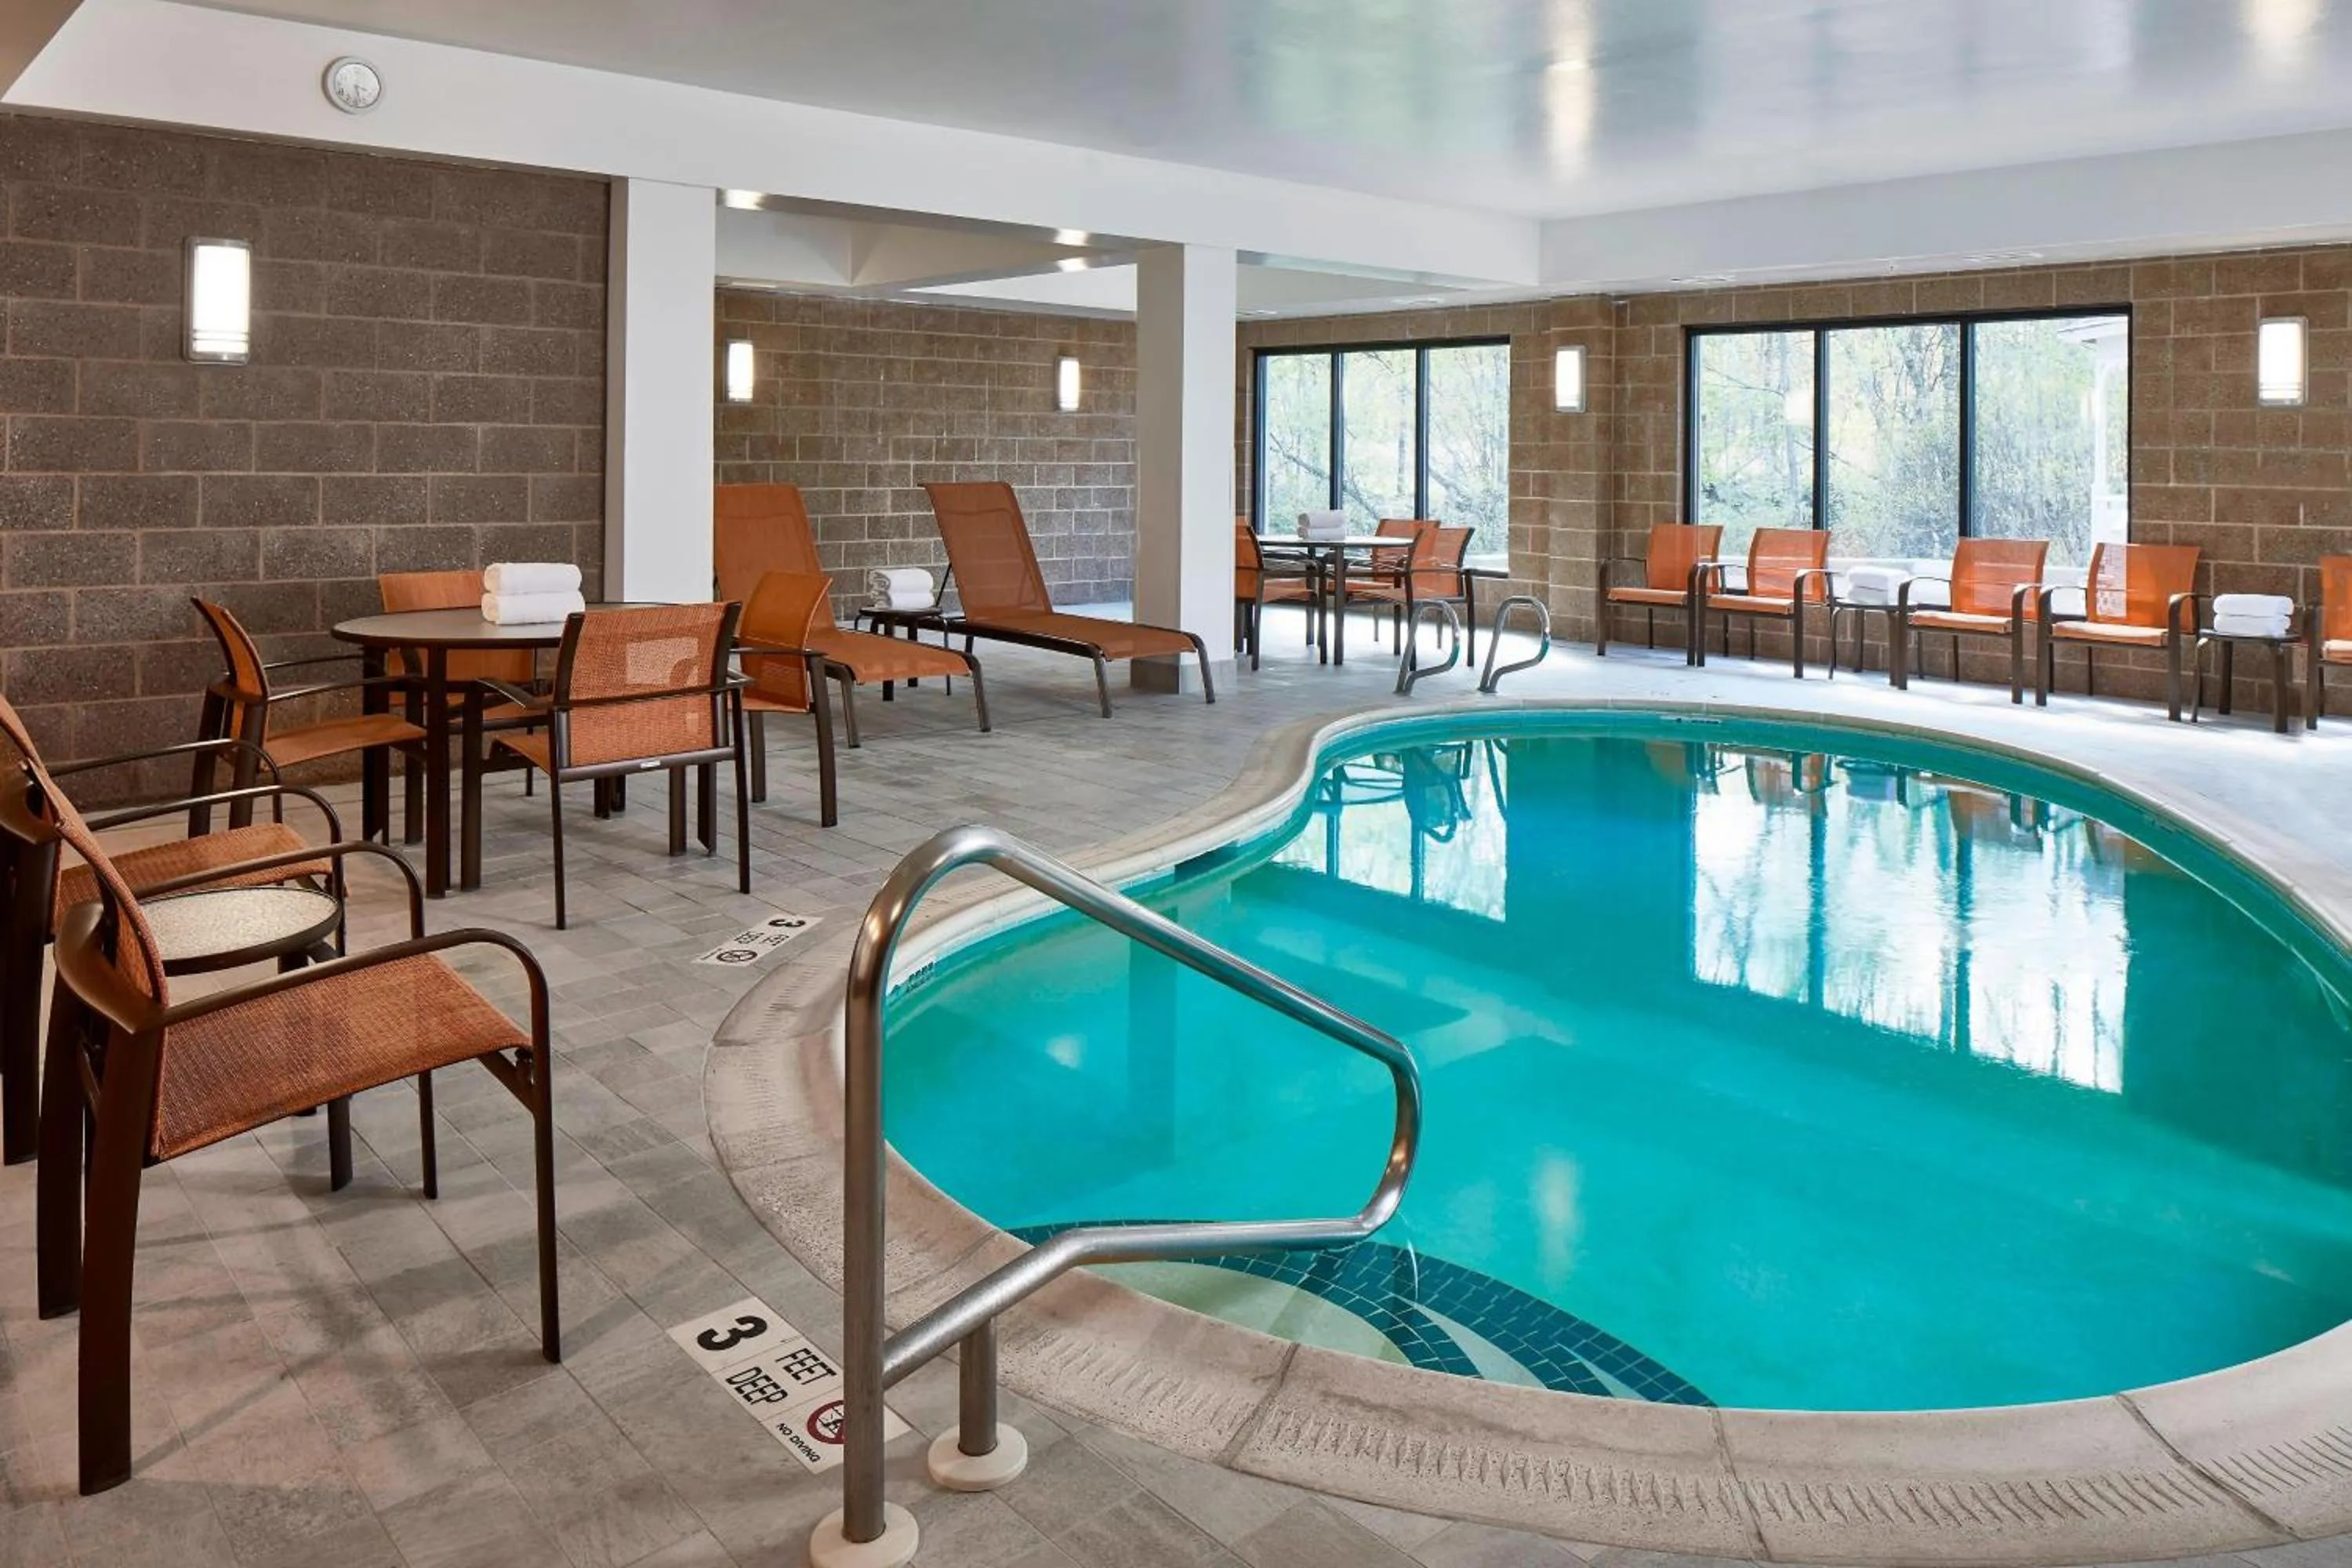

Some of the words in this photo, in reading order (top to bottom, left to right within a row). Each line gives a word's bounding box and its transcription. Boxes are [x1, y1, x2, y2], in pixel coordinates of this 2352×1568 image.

[697, 1316, 768, 1351] 3
[775, 1348, 837, 1385] FEET
[725, 1367, 788, 1406] DEEP
[777, 1423, 793, 1436] NO
[789, 1436, 821, 1462] DIVING
